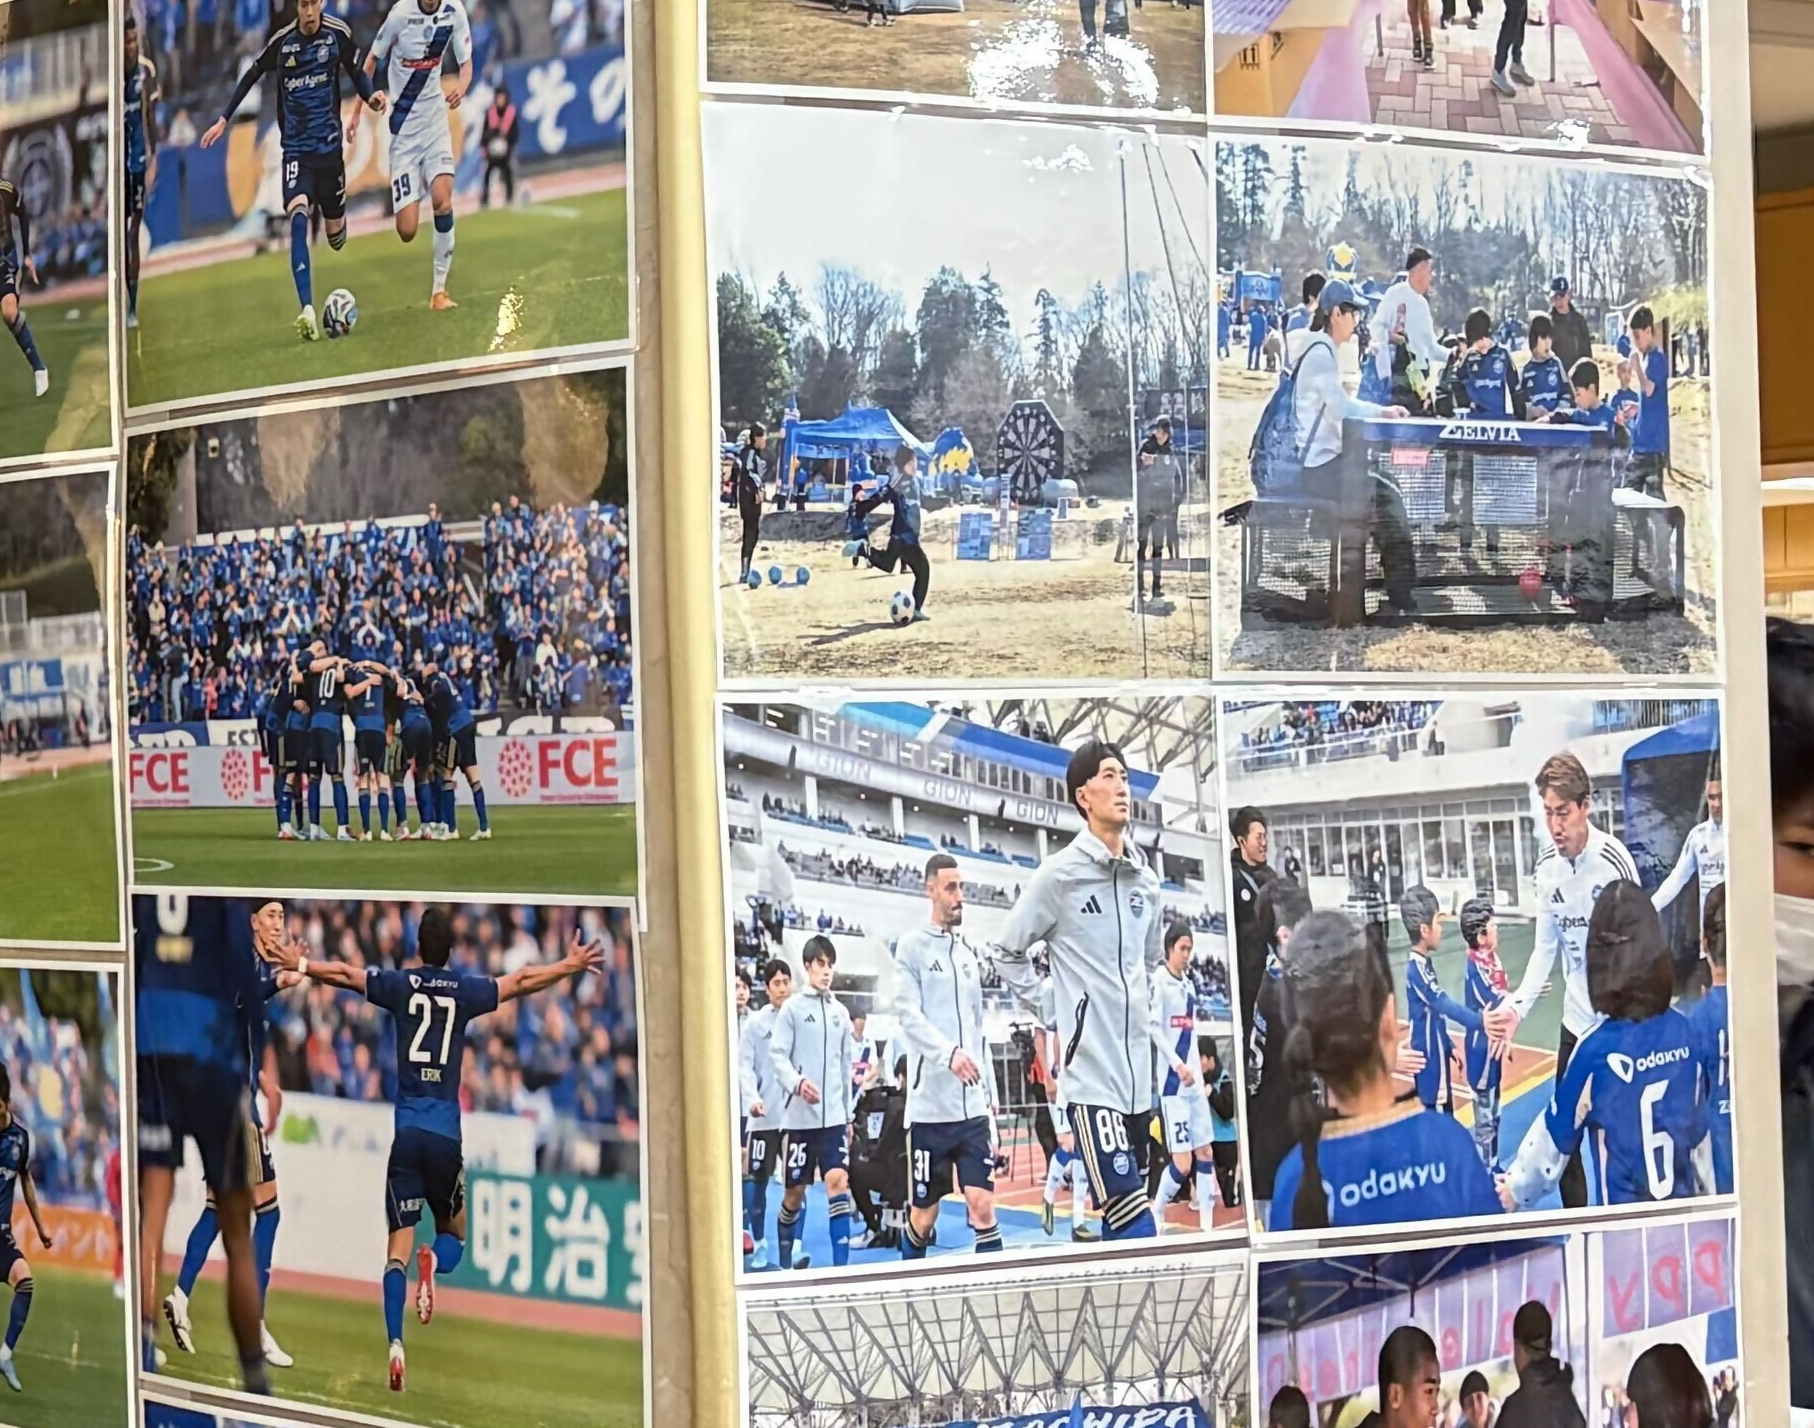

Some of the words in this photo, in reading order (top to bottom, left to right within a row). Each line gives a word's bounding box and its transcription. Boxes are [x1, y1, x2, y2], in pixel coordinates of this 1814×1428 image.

[286, 160, 298, 182] 19
[392, 172, 411, 203] 39
[1439, 425, 1522, 442] ZELVIA
[539, 737, 619, 789] FCE
[924, 777, 972, 806] GION
[1017, 801, 1060, 826] GION
[408, 993, 456, 1064] 27
[1635, 1044, 1690, 1073] odakyu
[420, 1067, 442, 1083] ERIK
[1095, 1108, 1130, 1154] 88
[1640, 1080, 1675, 1200] 6
[753, 1139, 766, 1161] 10
[787, 1142, 807, 1168] 26
[914, 1149, 931, 1182] 31
[1340, 1159, 1447, 1208] odakyu
[473, 1177, 642, 1309] 明治
